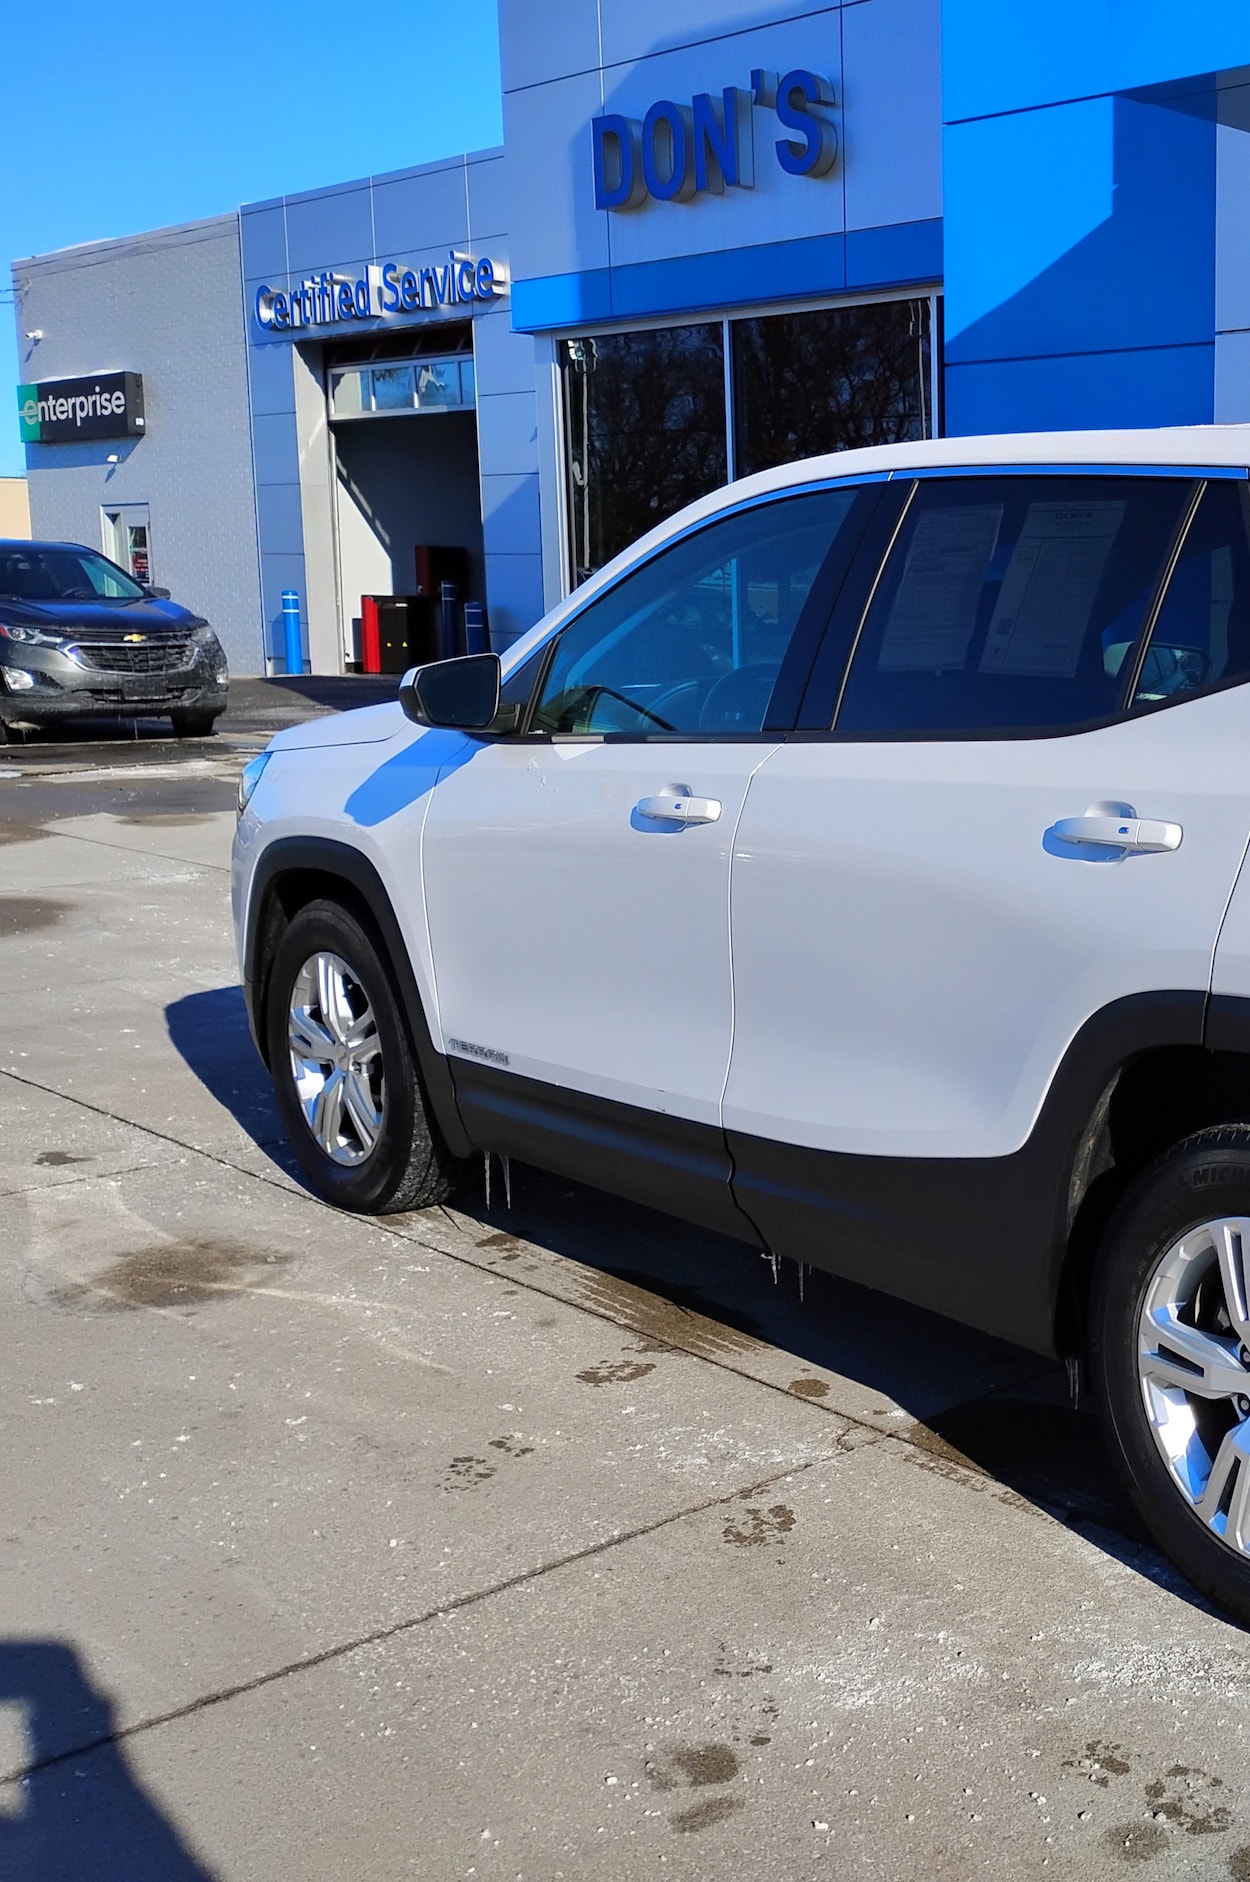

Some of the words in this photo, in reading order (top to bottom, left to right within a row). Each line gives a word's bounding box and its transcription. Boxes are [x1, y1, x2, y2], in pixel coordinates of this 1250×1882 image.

[591, 68, 835, 212] DON'S
[254, 264, 381, 331] Certified
[381, 250, 503, 313] Service
[19, 385, 126, 427] enterprise
